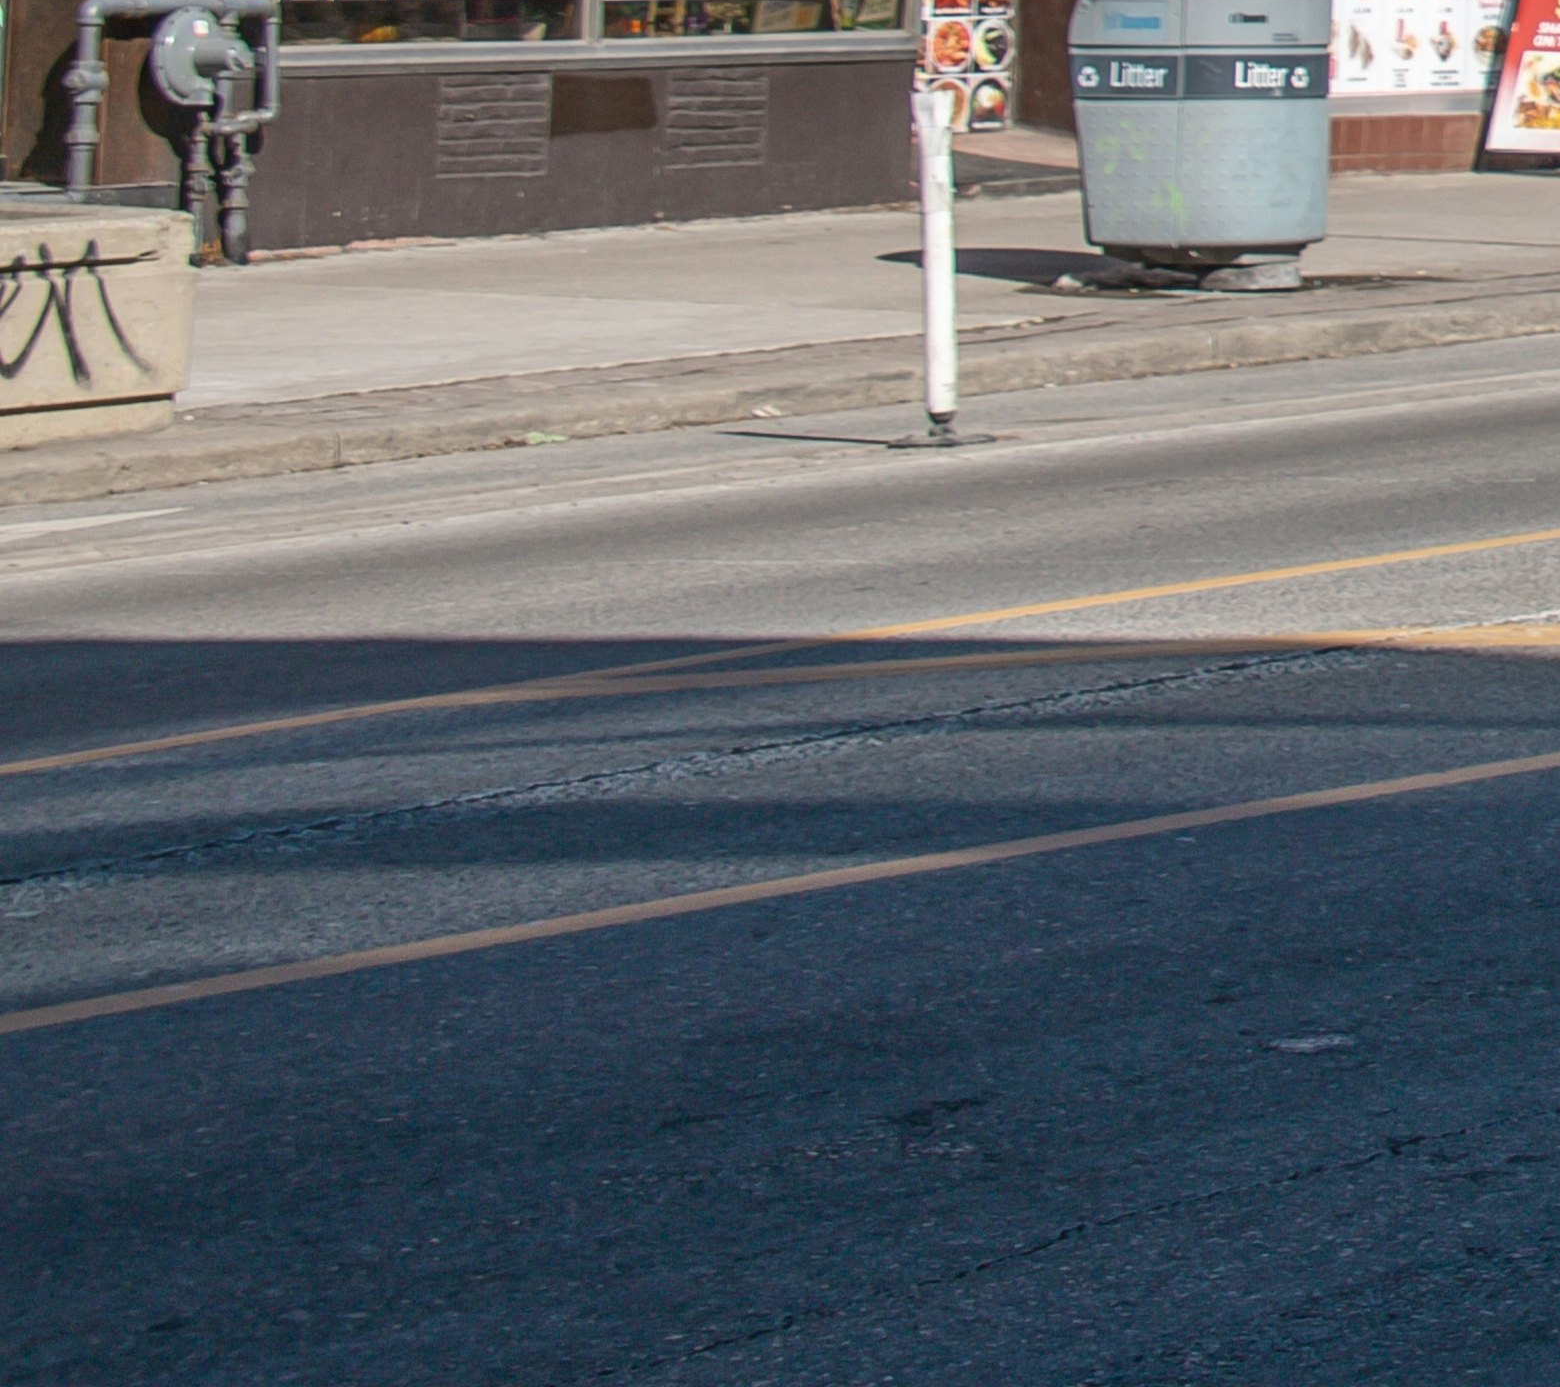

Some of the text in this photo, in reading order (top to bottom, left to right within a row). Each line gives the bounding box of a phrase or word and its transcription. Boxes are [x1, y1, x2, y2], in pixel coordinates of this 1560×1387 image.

[1532, 34, 1556, 47] ON
[1110, 60, 1168, 88] Litter
[1235, 60, 1289, 89] Litter
